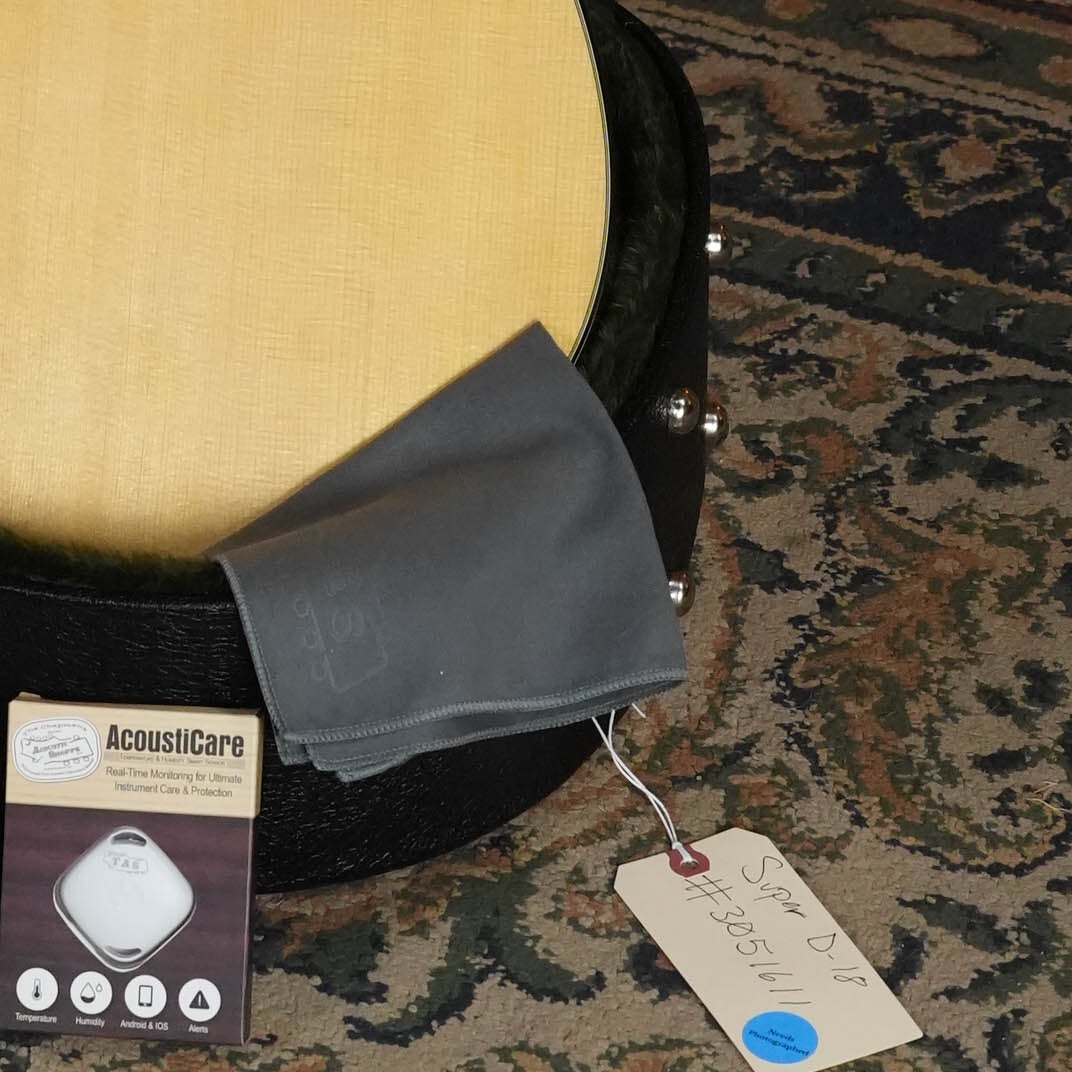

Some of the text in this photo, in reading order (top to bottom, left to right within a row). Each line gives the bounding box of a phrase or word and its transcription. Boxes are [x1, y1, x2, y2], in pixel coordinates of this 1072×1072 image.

[106, 724, 244, 758] AcoustiCare
[106, 766, 243, 784] Real-Time Monitoring for Ultimate
[114, 781, 233, 798] Instrument Care & Protection
[742, 856, 868, 987] Super D-18
[15, 1012, 57, 1024] Temperature
[75, 1017, 105, 1028] Humidity
[120, 1019, 147, 1030] Android
[148, 1021, 154, 1030] &
[189, 1024, 209, 1034] Alerts
[768, 1028, 795, 1042] Needs
[749, 1029, 810, 1056] Photographed
